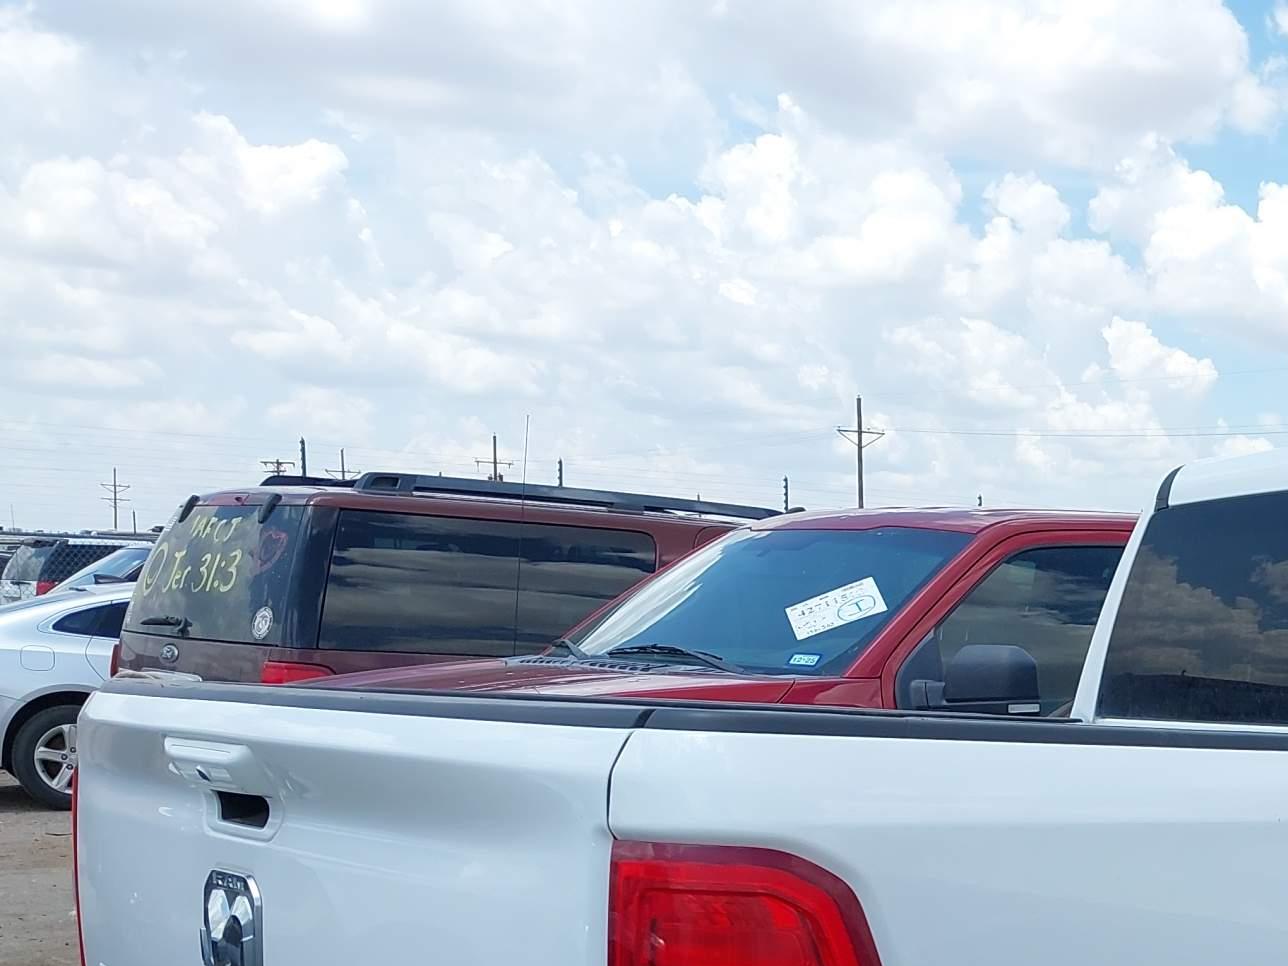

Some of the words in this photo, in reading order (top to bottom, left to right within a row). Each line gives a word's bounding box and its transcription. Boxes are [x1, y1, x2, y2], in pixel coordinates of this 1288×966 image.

[162, 549, 192, 593] Jer
[192, 548, 242, 593] 31:3
[212, 871, 245, 891] RAM
